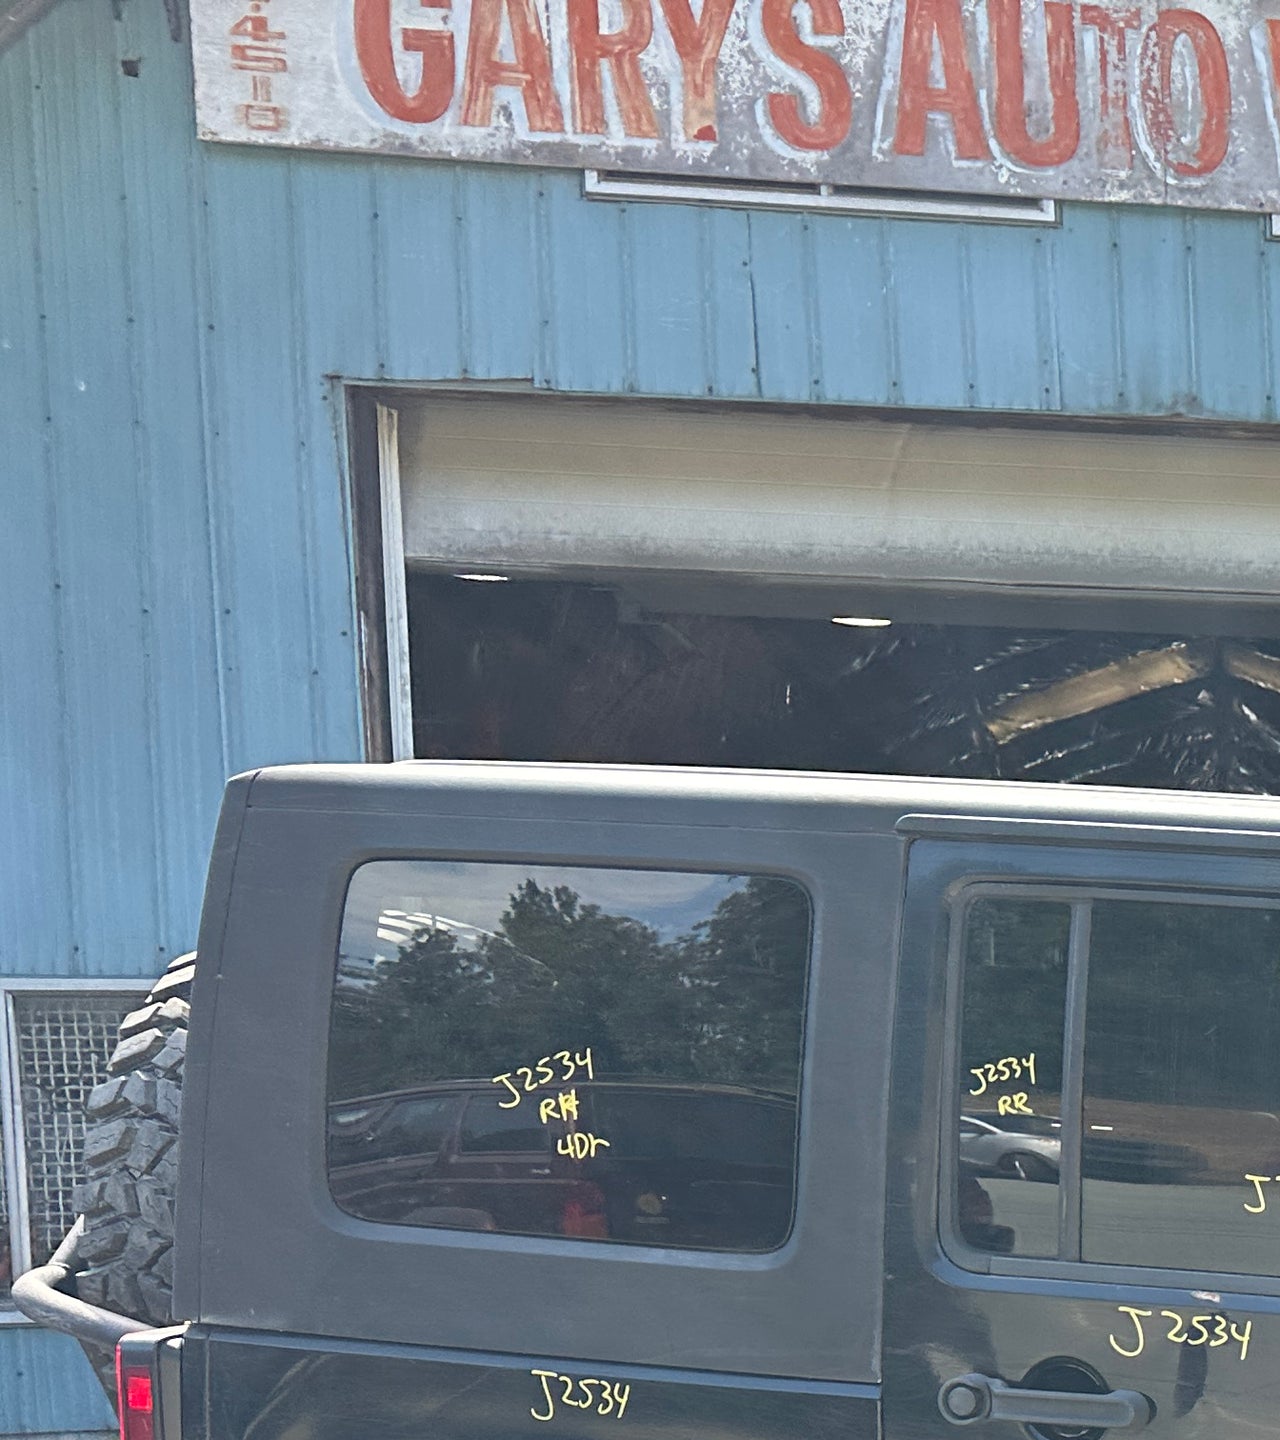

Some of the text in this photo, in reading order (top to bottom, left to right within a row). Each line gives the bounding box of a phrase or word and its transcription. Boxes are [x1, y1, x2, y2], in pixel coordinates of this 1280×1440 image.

[893, 0, 1231, 177] AUTO
[492, 1047, 594, 1109] J2534
[969, 1053, 1037, 1095] J2534
[998, 1092, 1033, 1115] RR
[1109, 1306, 1252, 1360] J2534
[531, 1369, 631, 1421] J2534
